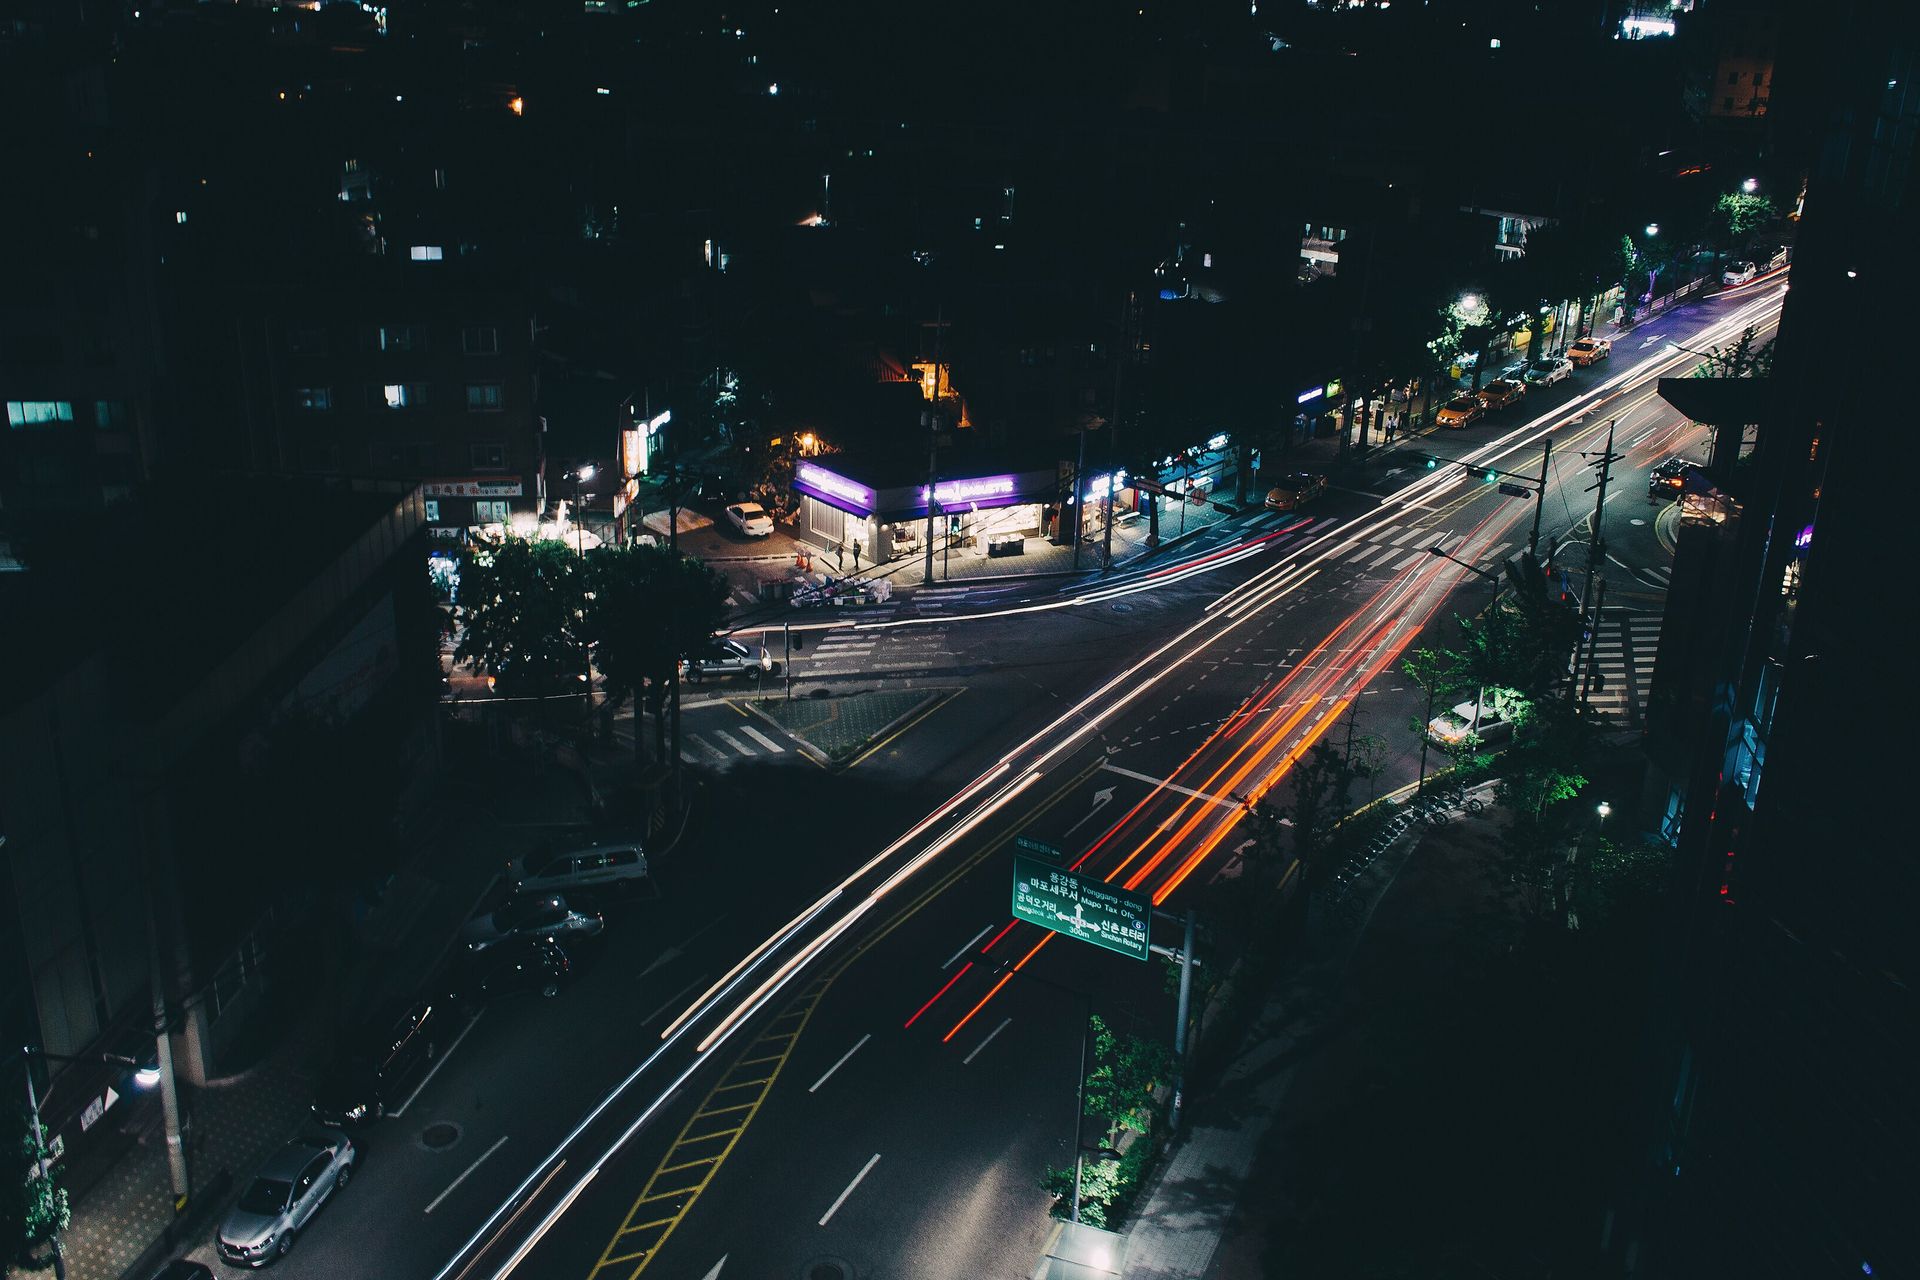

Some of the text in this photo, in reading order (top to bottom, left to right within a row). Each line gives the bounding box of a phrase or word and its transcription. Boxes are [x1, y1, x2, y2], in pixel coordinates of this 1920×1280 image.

[1030, 877, 1078, 902] 마포세무서
[1050, 872, 1079, 890] 용강동
[1017, 891, 1057, 914] 공덕오거리
[1081, 896, 1102, 909] Mapo
[1104, 903, 1118, 915] Tax
[1068, 925, 1090, 939] 300m
[1100, 919, 1145, 943] 신촌로터리
[1135, 921, 1142, 929] 6
[1100, 930, 1143, 951] Sinchon Rotary
